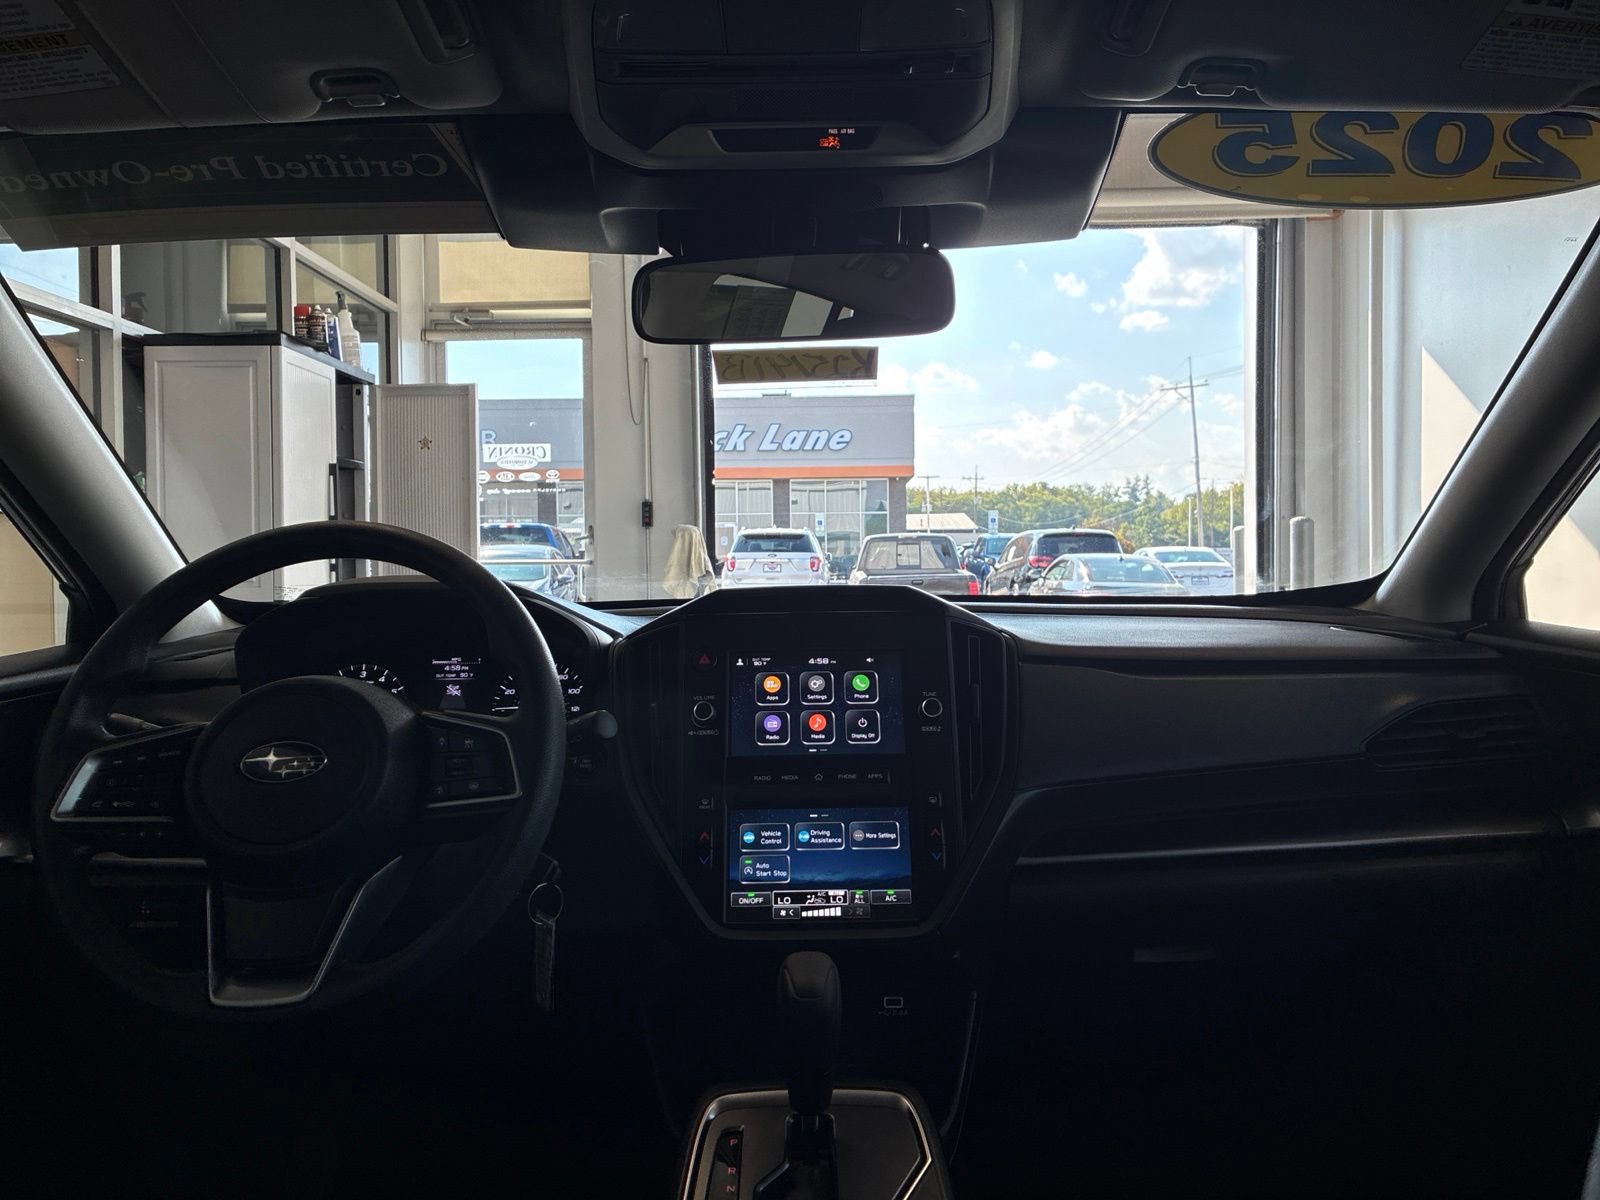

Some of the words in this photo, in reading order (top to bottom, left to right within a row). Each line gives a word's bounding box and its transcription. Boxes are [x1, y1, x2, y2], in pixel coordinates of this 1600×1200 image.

[757, 423, 853, 452] Lane
[808, 657, 829, 665] 4:58
[807, 693, 828, 701] Settings
[810, 829, 831, 837] Driving
[877, 832, 897, 840] Settings
[738, 896, 764, 905] ON/OFF
[777, 896, 791, 905] LO
[830, 896, 844, 904] LO
[885, 894, 897, 902] A/C
[730, 1138, 738, 1146] P
[726, 1185, 735, 1193] N
